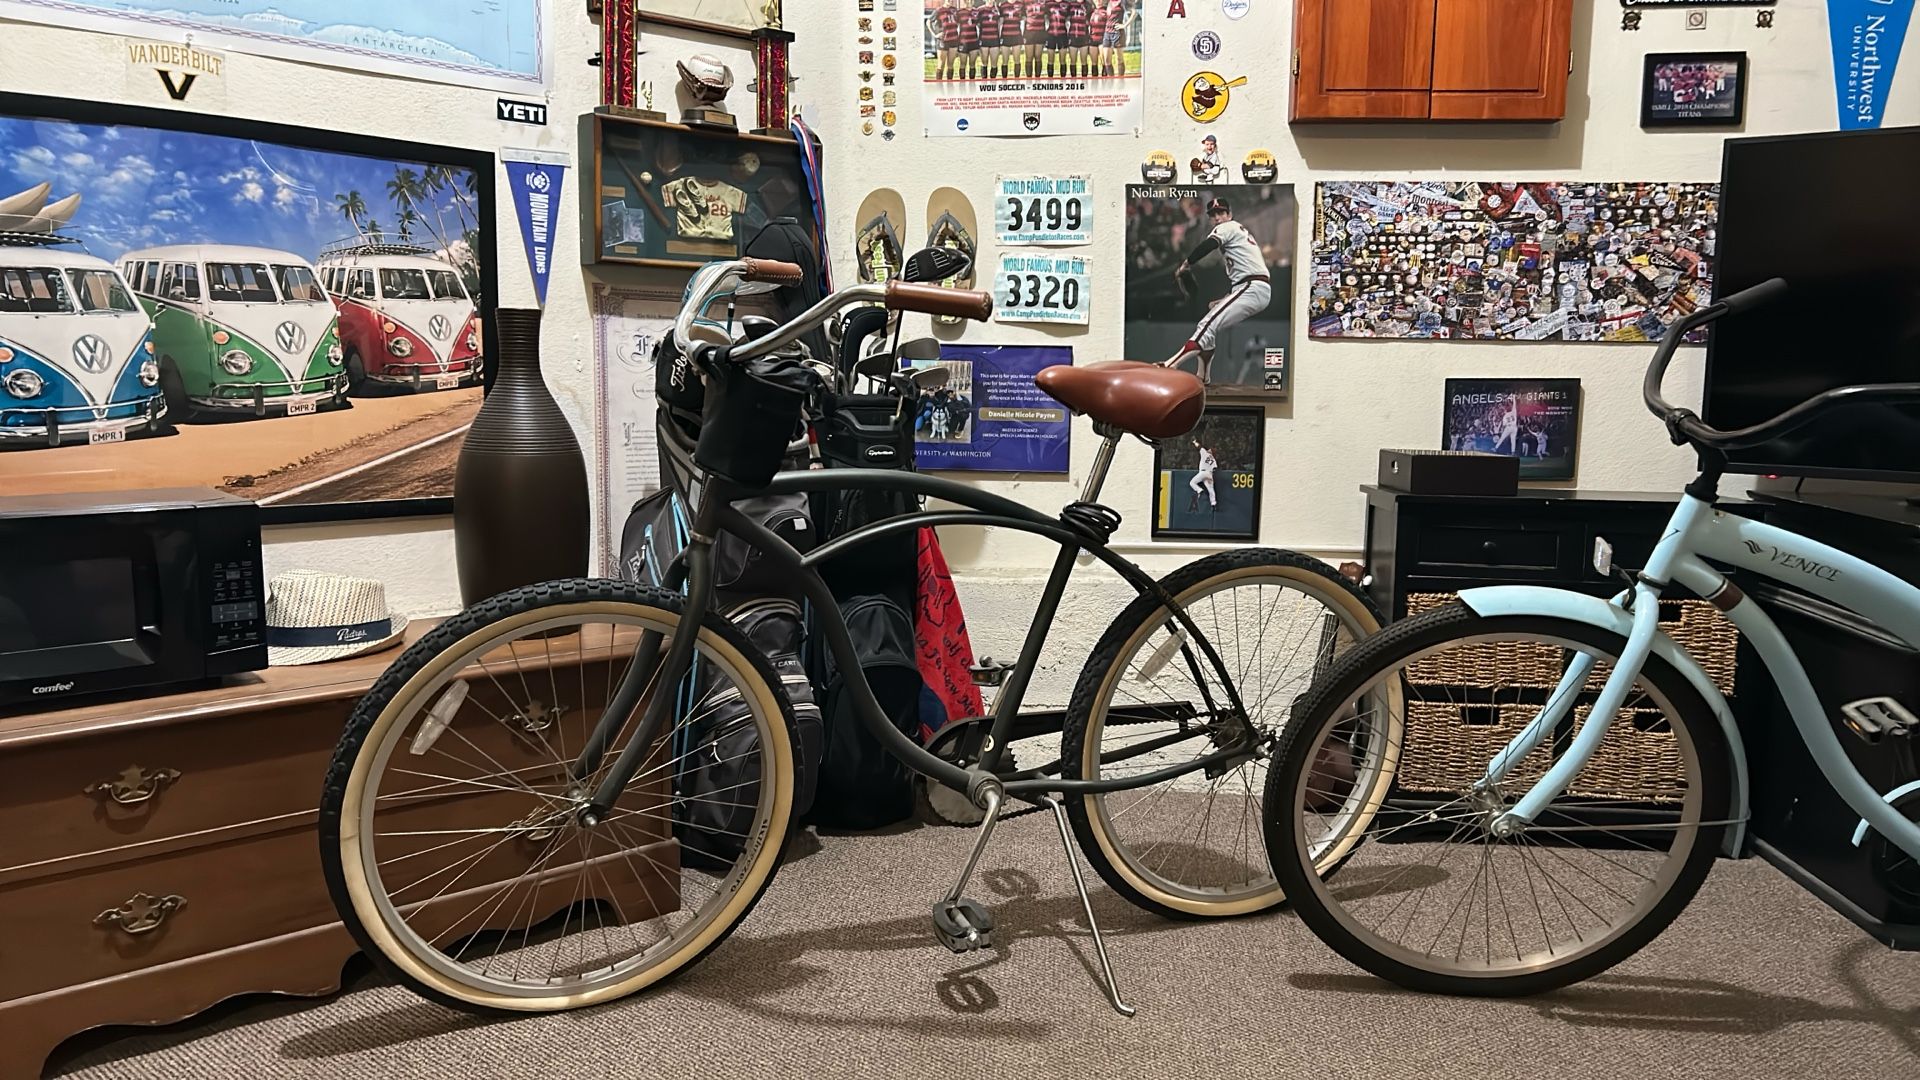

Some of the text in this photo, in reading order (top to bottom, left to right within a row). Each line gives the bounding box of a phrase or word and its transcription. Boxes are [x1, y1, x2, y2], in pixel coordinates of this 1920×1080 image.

[353, 36, 437, 56] ANTARCTICA
[129, 44, 222, 76] VANDERBILT
[1847, 25, 1862, 110] UNIVERSITY
[1858, 15, 1886, 122] Northwest
[154, 68, 198, 100] V
[979, 84, 996, 92] WOU
[998, 83, 1026, 91] SOCCER
[1032, 83, 1064, 91] SENIORS
[499, 102, 546, 123] YETI
[1003, 181, 1025, 194] WORLD
[1056, 181, 1070, 194] MUD
[1072, 180, 1086, 194] RUN
[1131, 187, 1198, 201] Nolan Ryan
[529, 192, 549, 243] MOUNTAIN
[1007, 197, 1082, 231] 3499
[534, 246, 547, 274] LIONS
[1003, 258, 1025, 272] WORLD
[1056, 259, 1070, 273] MUD
[1071, 259, 1085, 274] RUN
[1006, 274, 1079, 310] 3320
[670, 355, 687, 392] Title
[1452, 393, 1503, 405] ANGELS
[1526, 391, 1560, 401] GIANTS
[289, 403, 315, 414] CMPR 2
[92, 431, 124, 443] CMPR 1
[949, 450, 992, 458] WASHINGTON
[1232, 473, 1254, 488] 396
[1771, 546, 1843, 582] VENICE
[336, 628, 368, 641] Padres
